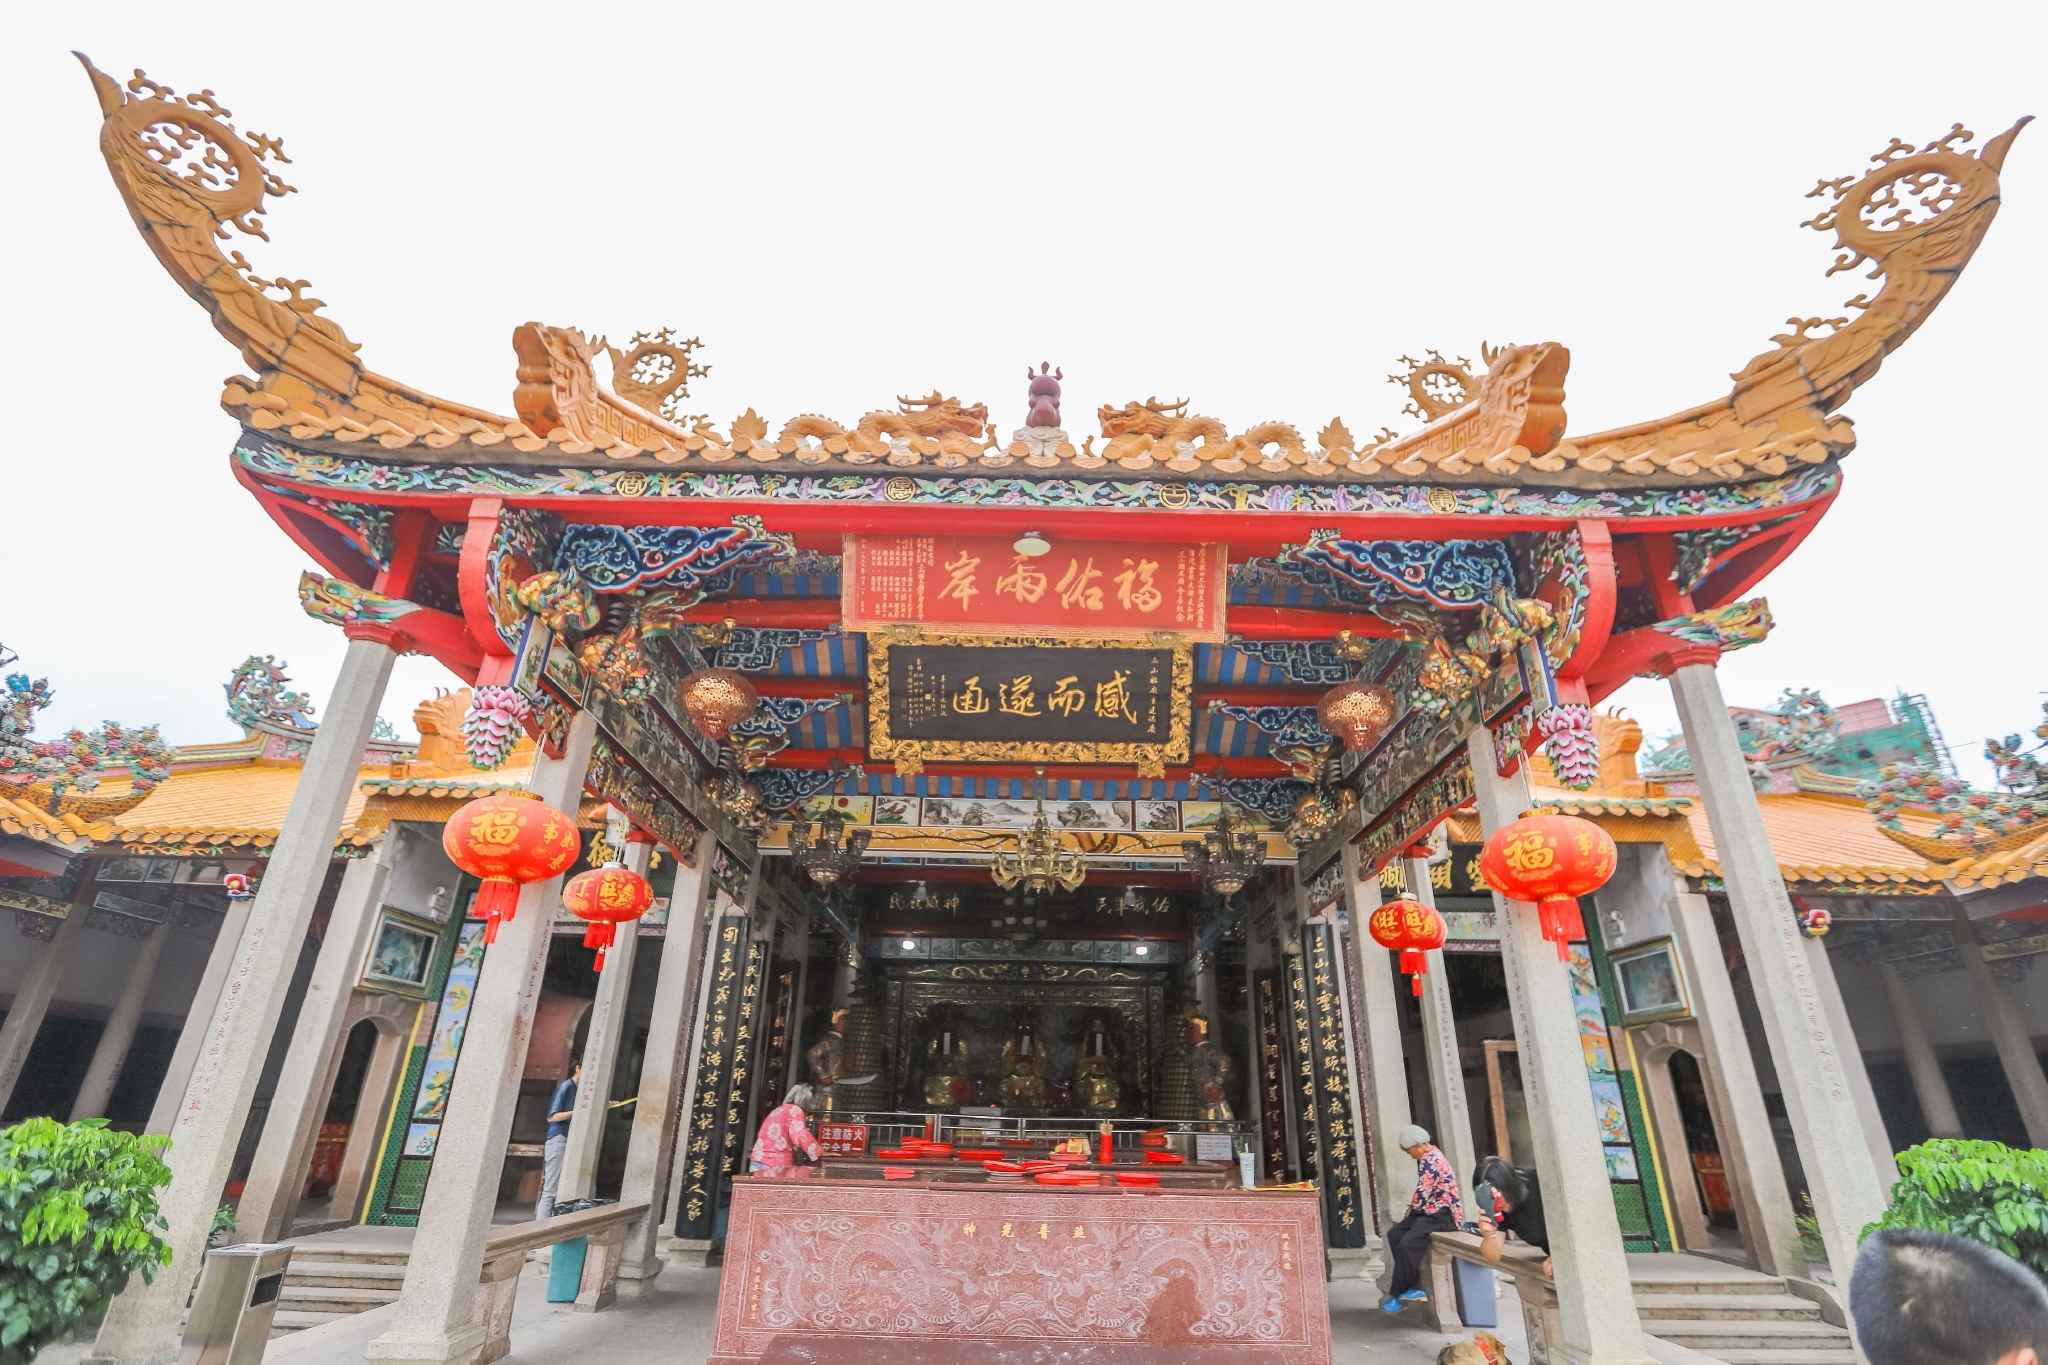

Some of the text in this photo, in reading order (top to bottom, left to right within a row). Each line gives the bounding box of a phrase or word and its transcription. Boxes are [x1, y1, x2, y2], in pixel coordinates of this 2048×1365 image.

[470, 805, 520, 845] 福
[1503, 829, 1554, 872] 福
[821, 1127, 863, 1141] 注意防火
[821, 1142, 862, 1152] 安全第一
